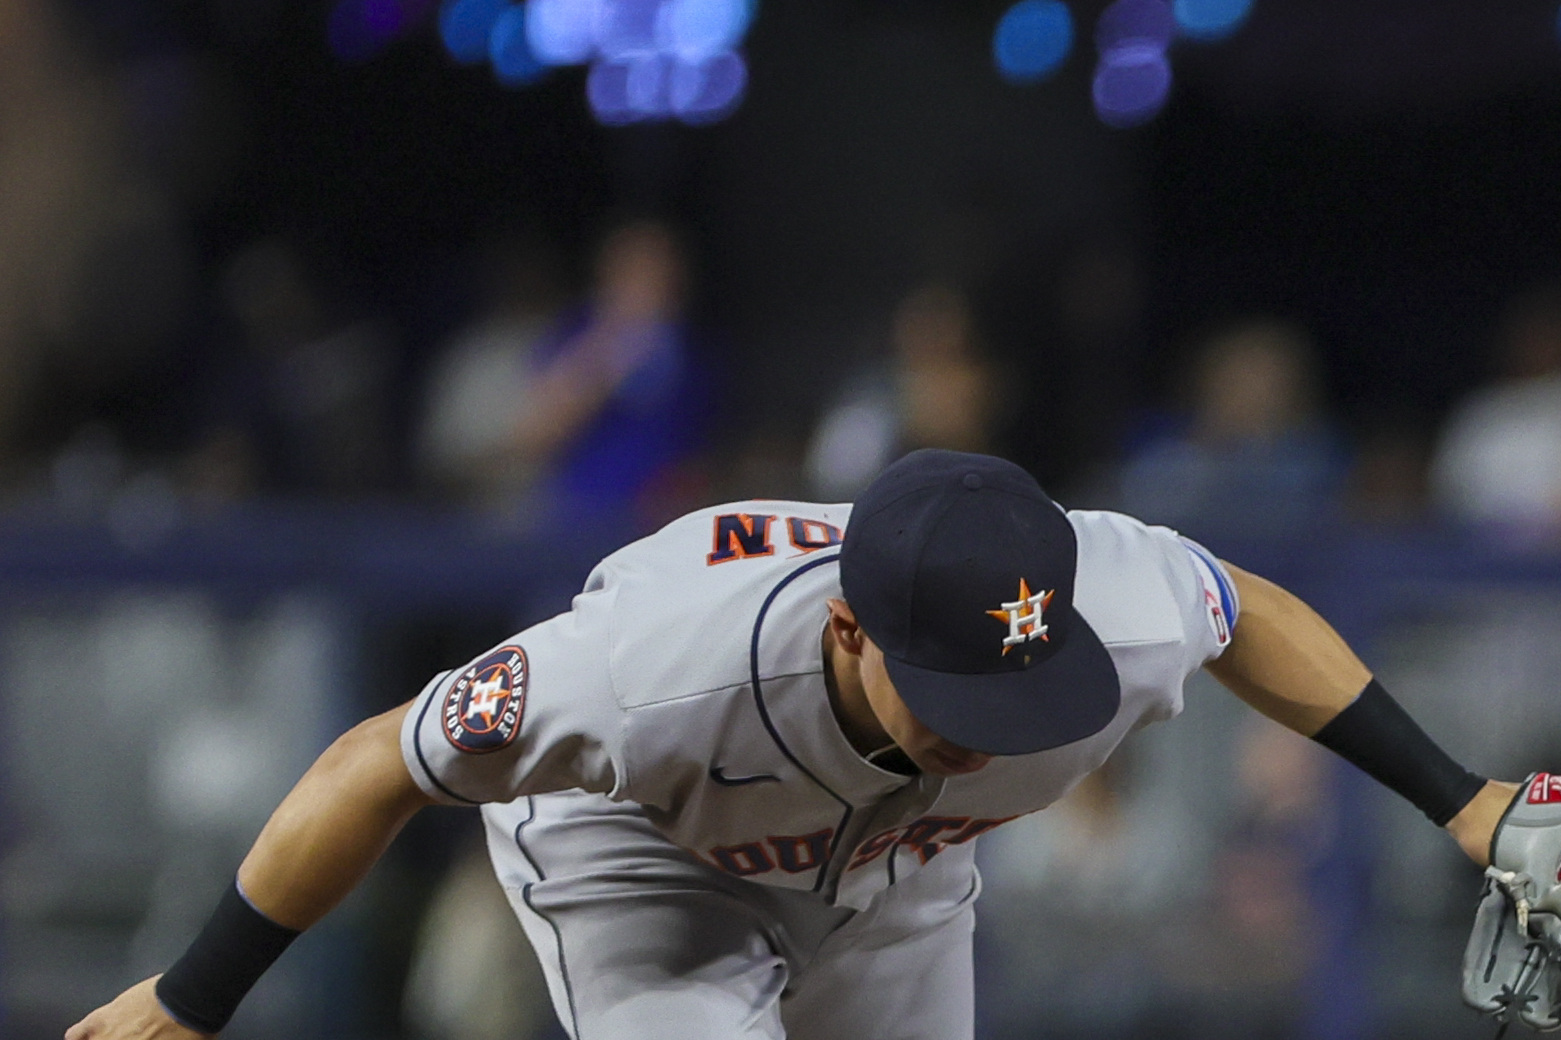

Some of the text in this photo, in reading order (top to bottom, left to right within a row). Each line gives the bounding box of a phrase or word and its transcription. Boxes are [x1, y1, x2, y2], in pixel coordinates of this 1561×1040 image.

[1001, 590, 1048, 646] H
[446, 667, 477, 740] ASTROS
[467, 676, 503, 719] H
[498, 653, 523, 739] HOUSTON
